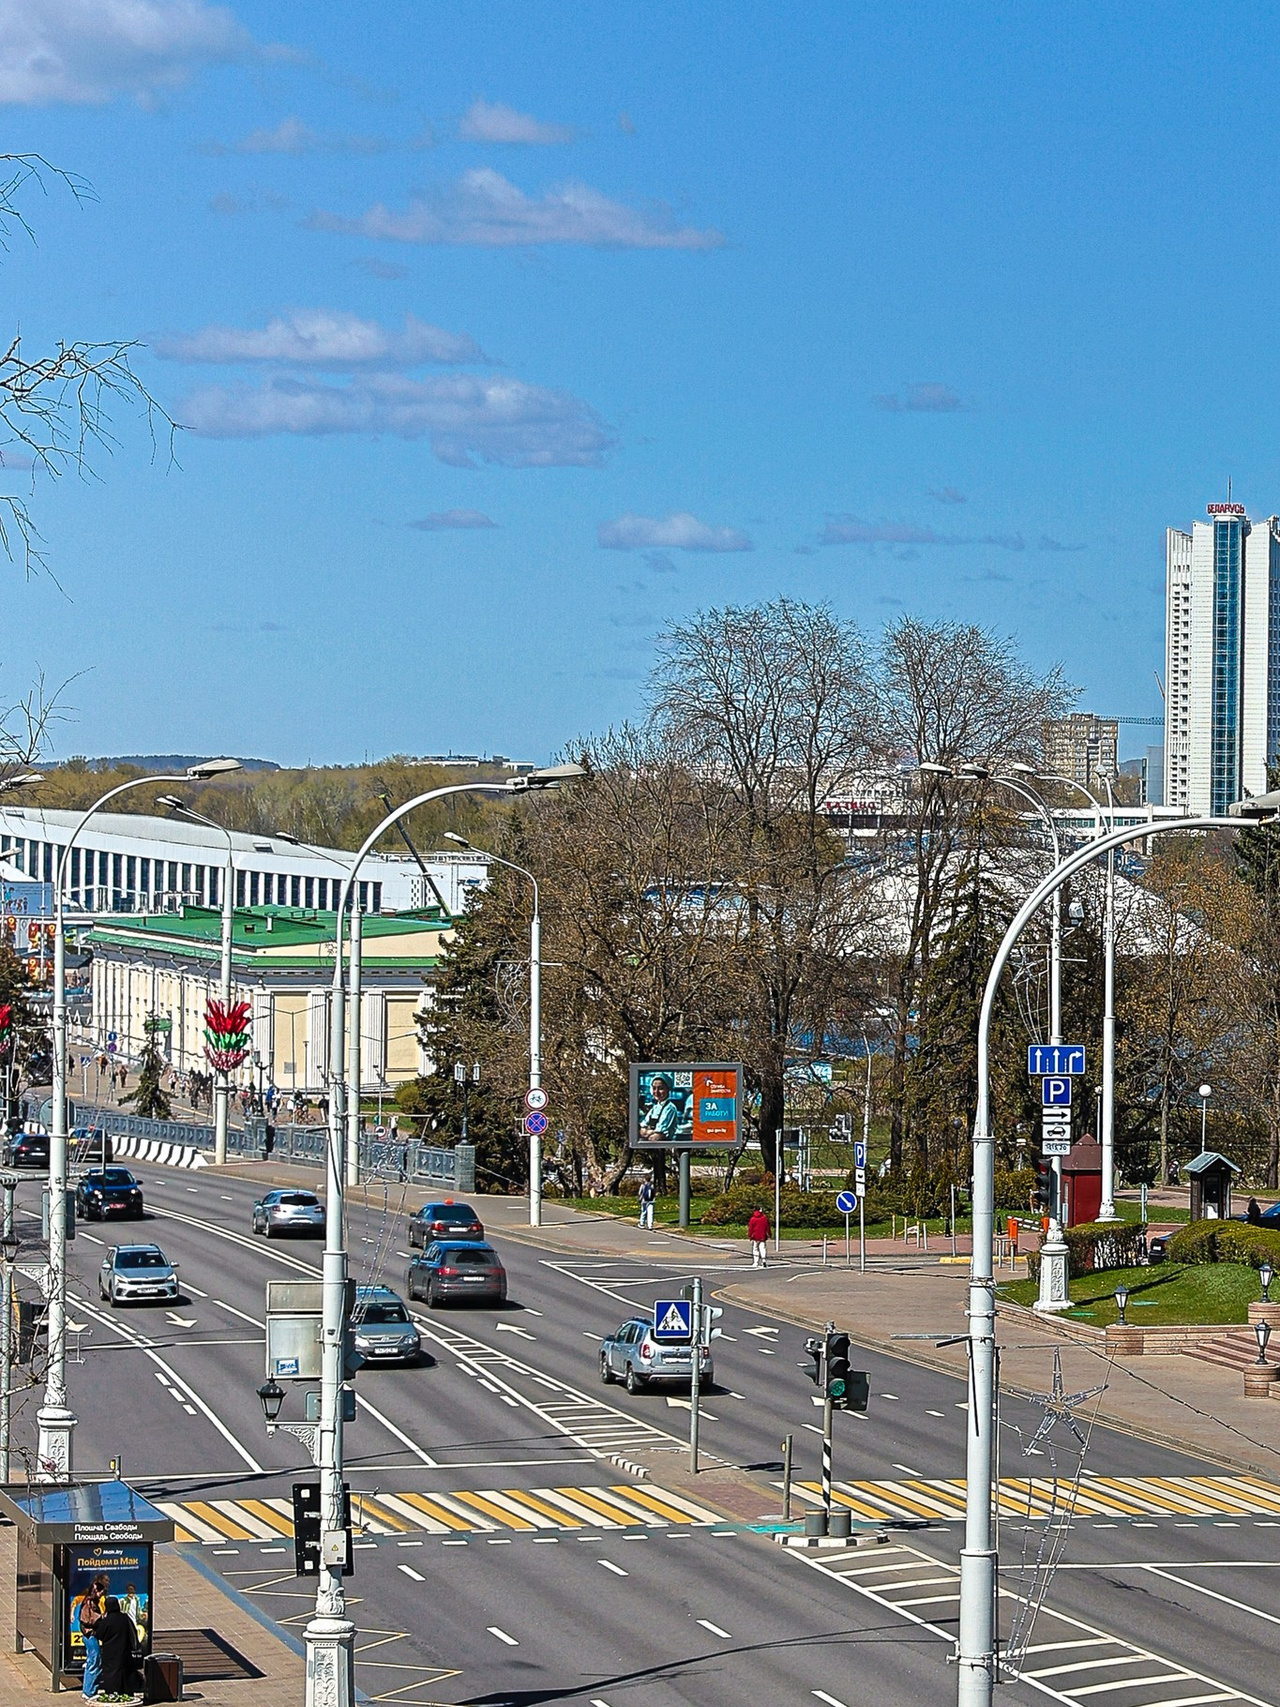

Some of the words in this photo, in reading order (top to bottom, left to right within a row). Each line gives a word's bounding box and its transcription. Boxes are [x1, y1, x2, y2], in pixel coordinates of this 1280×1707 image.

[1207, 503, 1245, 514] БЕЛАРУСЬ
[1050, 1081, 1065, 1102] P
[705, 1102, 718, 1110] ЗА
[857, 1145, 863, 1165] P
[74, 1524, 103, 1532] Плошча
[104, 1523, 138, 1532] Свабоды
[74, 1533, 108, 1541] Площадь
[109, 1532, 143, 1541] Свободы
[77, 1558, 112, 1567] Пойдем
[120, 1557, 138, 1565] Мак
